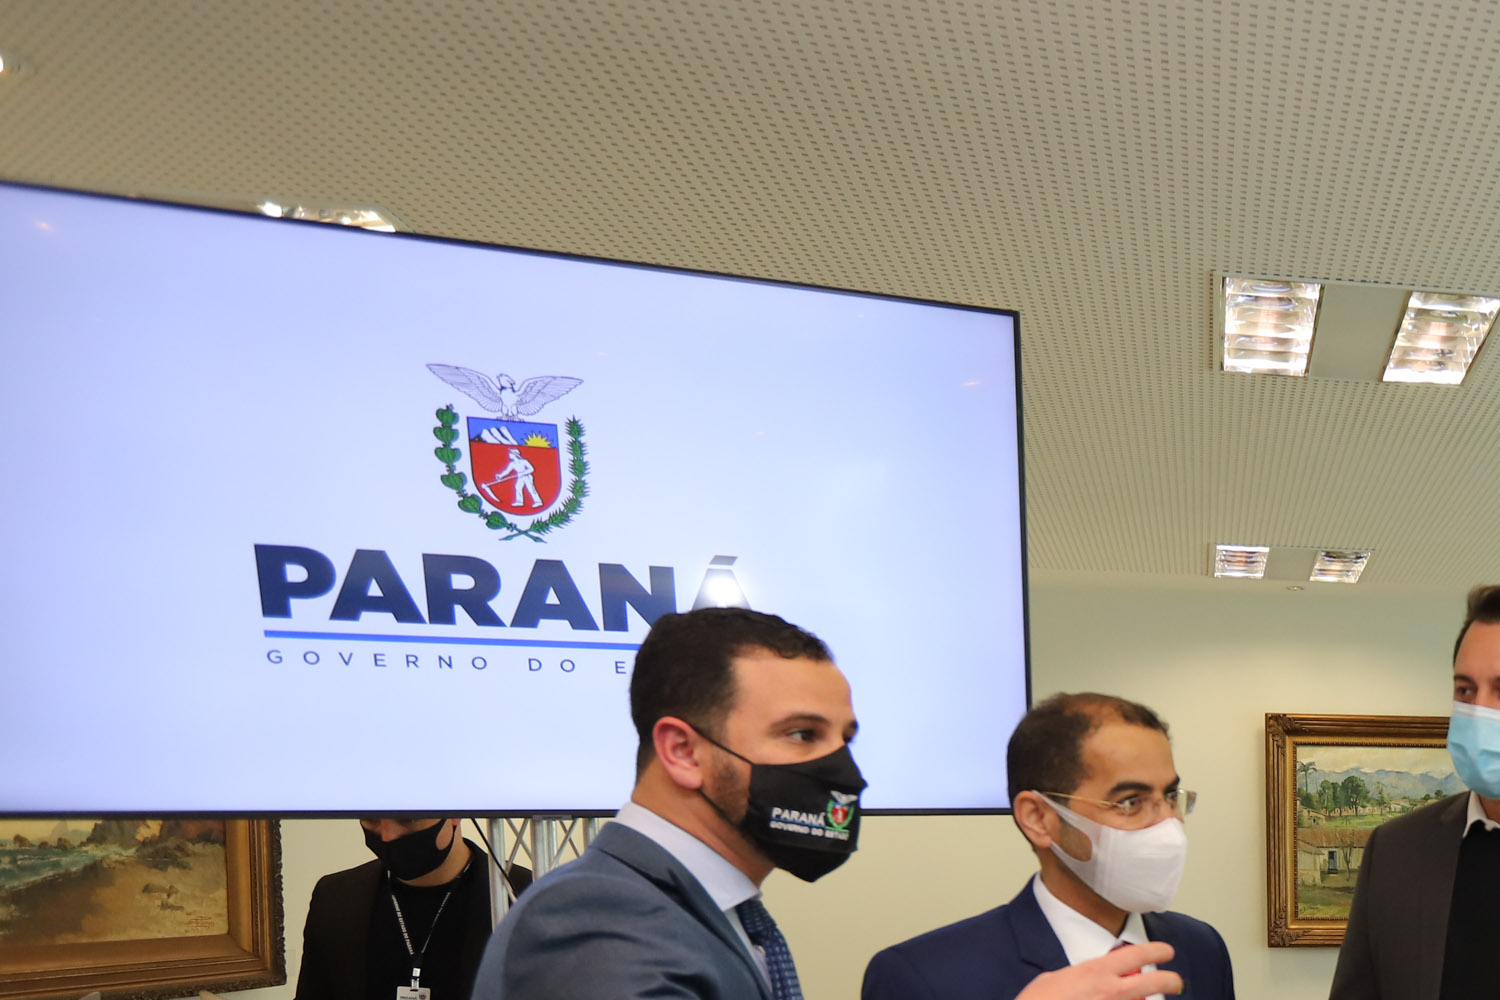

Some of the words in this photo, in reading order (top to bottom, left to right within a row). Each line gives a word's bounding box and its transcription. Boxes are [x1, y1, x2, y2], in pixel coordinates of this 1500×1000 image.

[266, 649, 488, 671] GOVERNO
[527, 657, 576, 673] DO
[771, 806, 826, 826] PARANÁ
